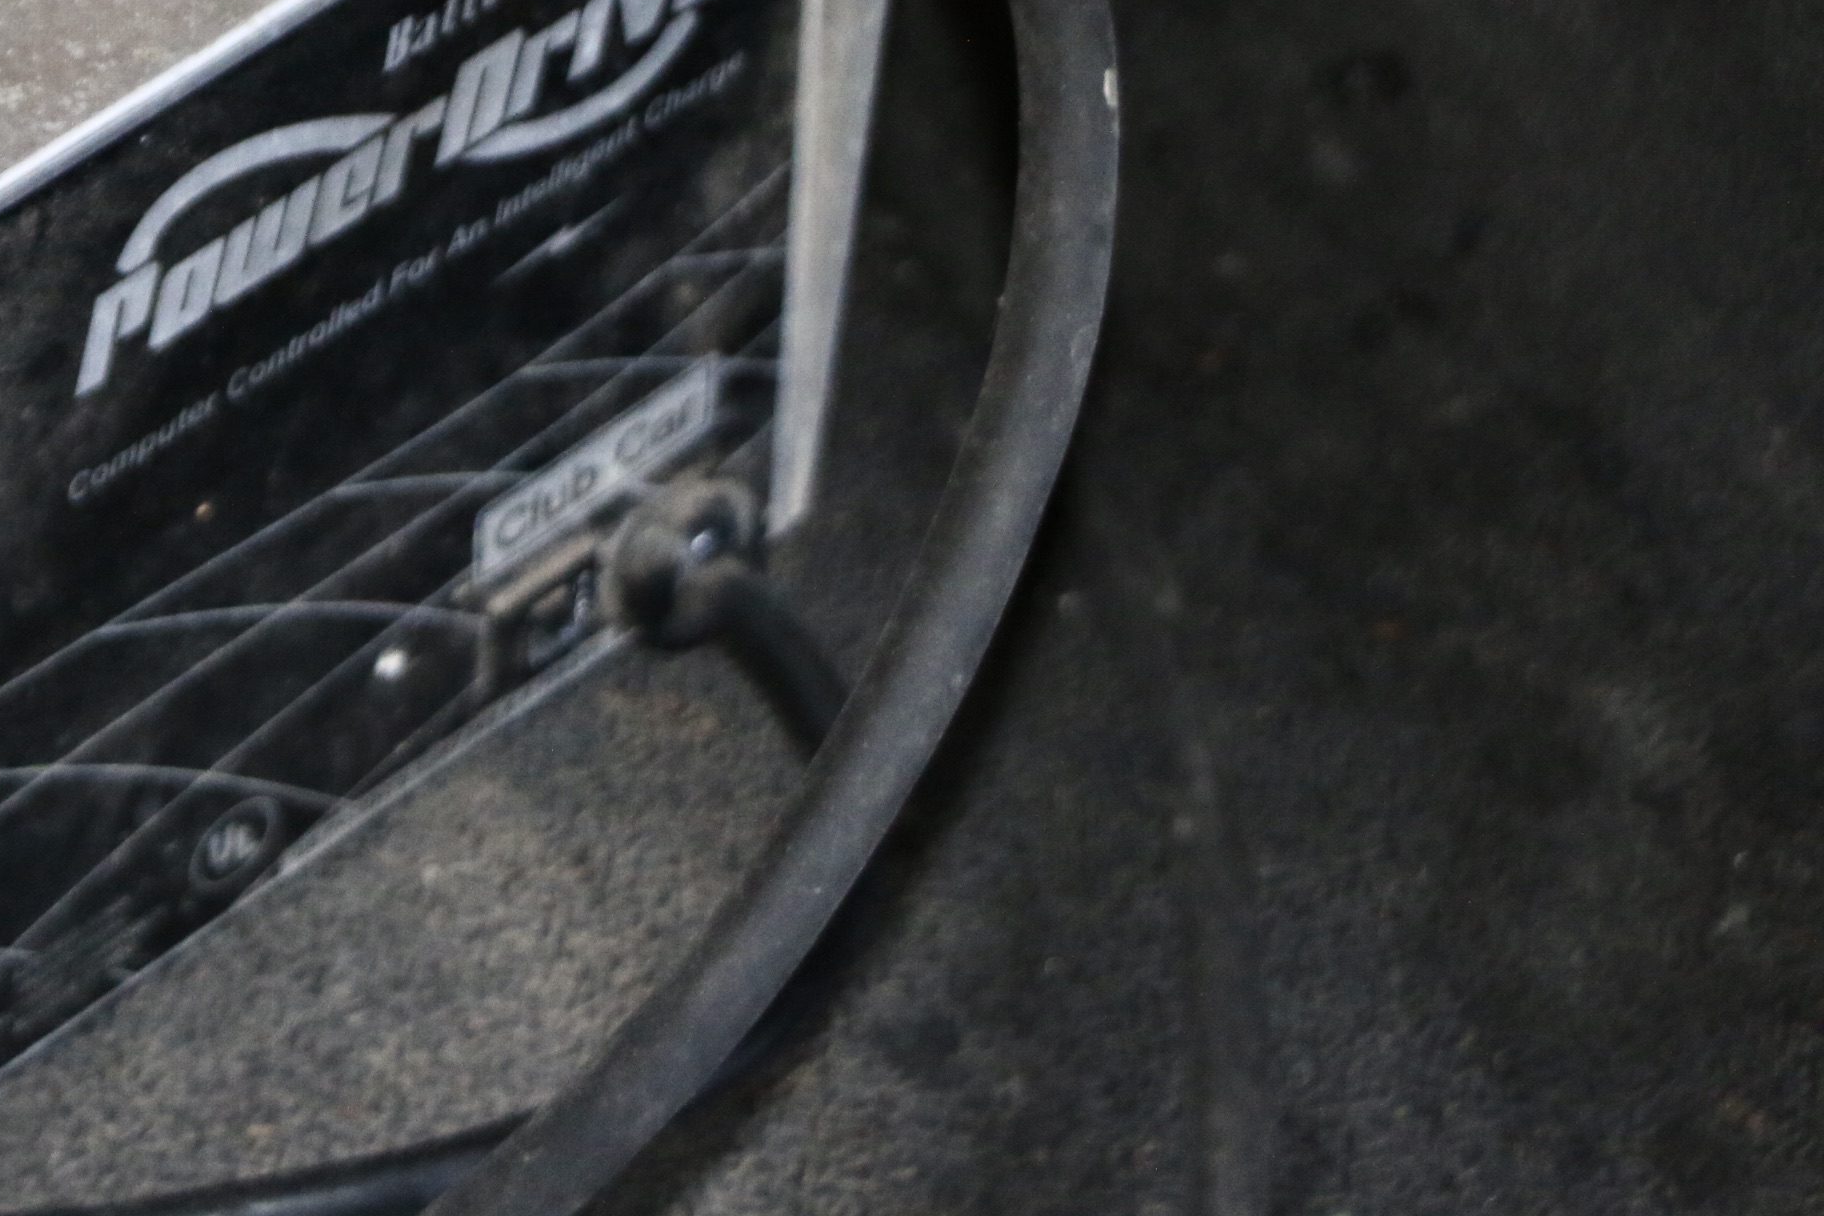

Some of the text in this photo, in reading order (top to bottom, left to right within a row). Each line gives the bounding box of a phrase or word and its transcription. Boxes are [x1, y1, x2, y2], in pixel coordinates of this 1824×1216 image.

[66, 51, 744, 503] Computer Controlled For An Intelligent Charge
[495, 395, 698, 548] Club Car
